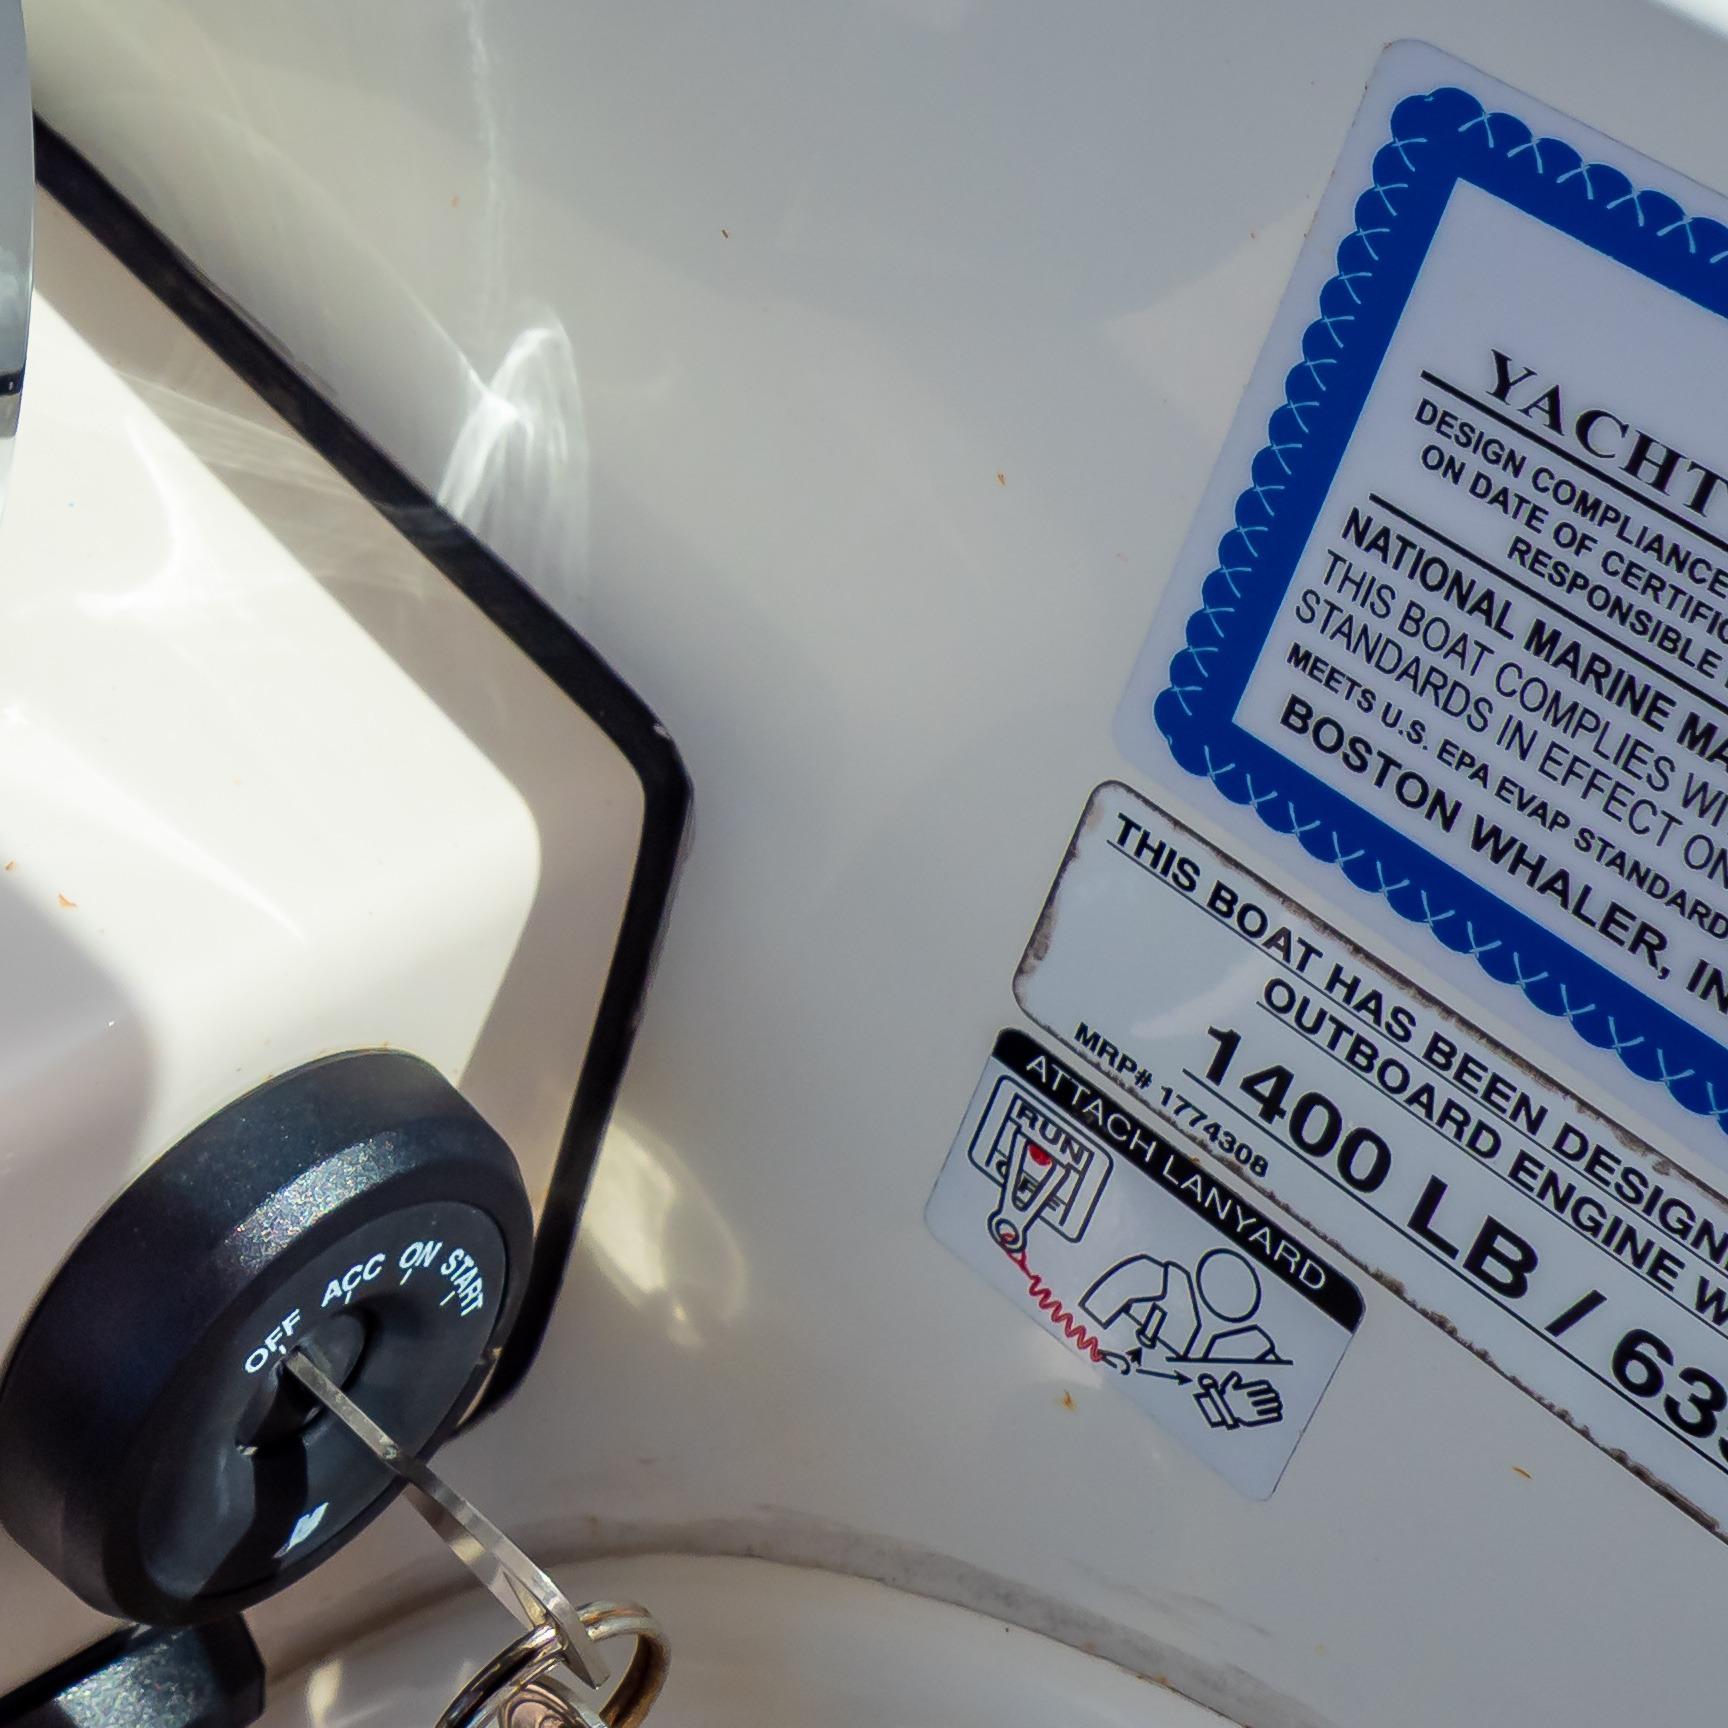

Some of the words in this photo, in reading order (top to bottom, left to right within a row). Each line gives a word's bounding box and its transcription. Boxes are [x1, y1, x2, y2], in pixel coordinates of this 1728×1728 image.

[1414, 397, 1528, 478] DESIGN
[1531, 465, 1728, 600] COMPLIANCE
[1420, 443, 1464, 485] ON
[1469, 473, 1550, 534] DATE
[1552, 521, 1598, 557] OF
[1486, 347, 1728, 518] YACHT
[1321, 549, 1397, 620] THIS
[1397, 598, 1495, 684] BOAT
[1495, 661, 1676, 792] COMPLIES
[1341, 507, 1515, 641] NATIONAL
[1523, 618, 1678, 732] MARINE
[1507, 535, 1723, 680] RESPONSIBLE
[1287, 642, 1377, 713] MEETS
[1381, 706, 1429, 752] U.S.
[1436, 741, 1489, 789] EPA
[1495, 775, 1571, 832] EVAP
[1573, 827, 1728, 940] STANDARD
[1296, 588, 1495, 735] STANDARDS
[1495, 714, 1538, 761] IN
[1538, 740, 1683, 847] EFFECT
[1280, 694, 1463, 833] BOSTON
[1470, 814, 1671, 980] WHALER,
[1115, 812, 1201, 893] THIS
[1207, 878, 1324, 974] BOAT
[1324, 966, 1417, 1043] HAS
[1421, 1030, 1548, 1136] BEEN
[1015, 1102, 1086, 1166] RUN
[1026, 1054, 1158, 1164] ATTACH
[1162, 1154, 1327, 1294] LANYARD
[1074, 1022, 1154, 1089] MRP#
[1160, 1084, 1270, 1178] 1774308
[1263, 977, 1502, 1166] OUTBOARD
[1508, 1148, 1686, 1292] ENGINE
[244, 1308, 301, 1374] OFF
[320, 1252, 386, 1308] ACC
[399, 1240, 443, 1269] ON
[440, 1247, 484, 1317] START
[1207, 1025, 1393, 1194] 1400
[1406, 1175, 1538, 1299] LB
[1544, 1288, 1607, 1337] /
[1612, 1328, 1728, 1462] 63
